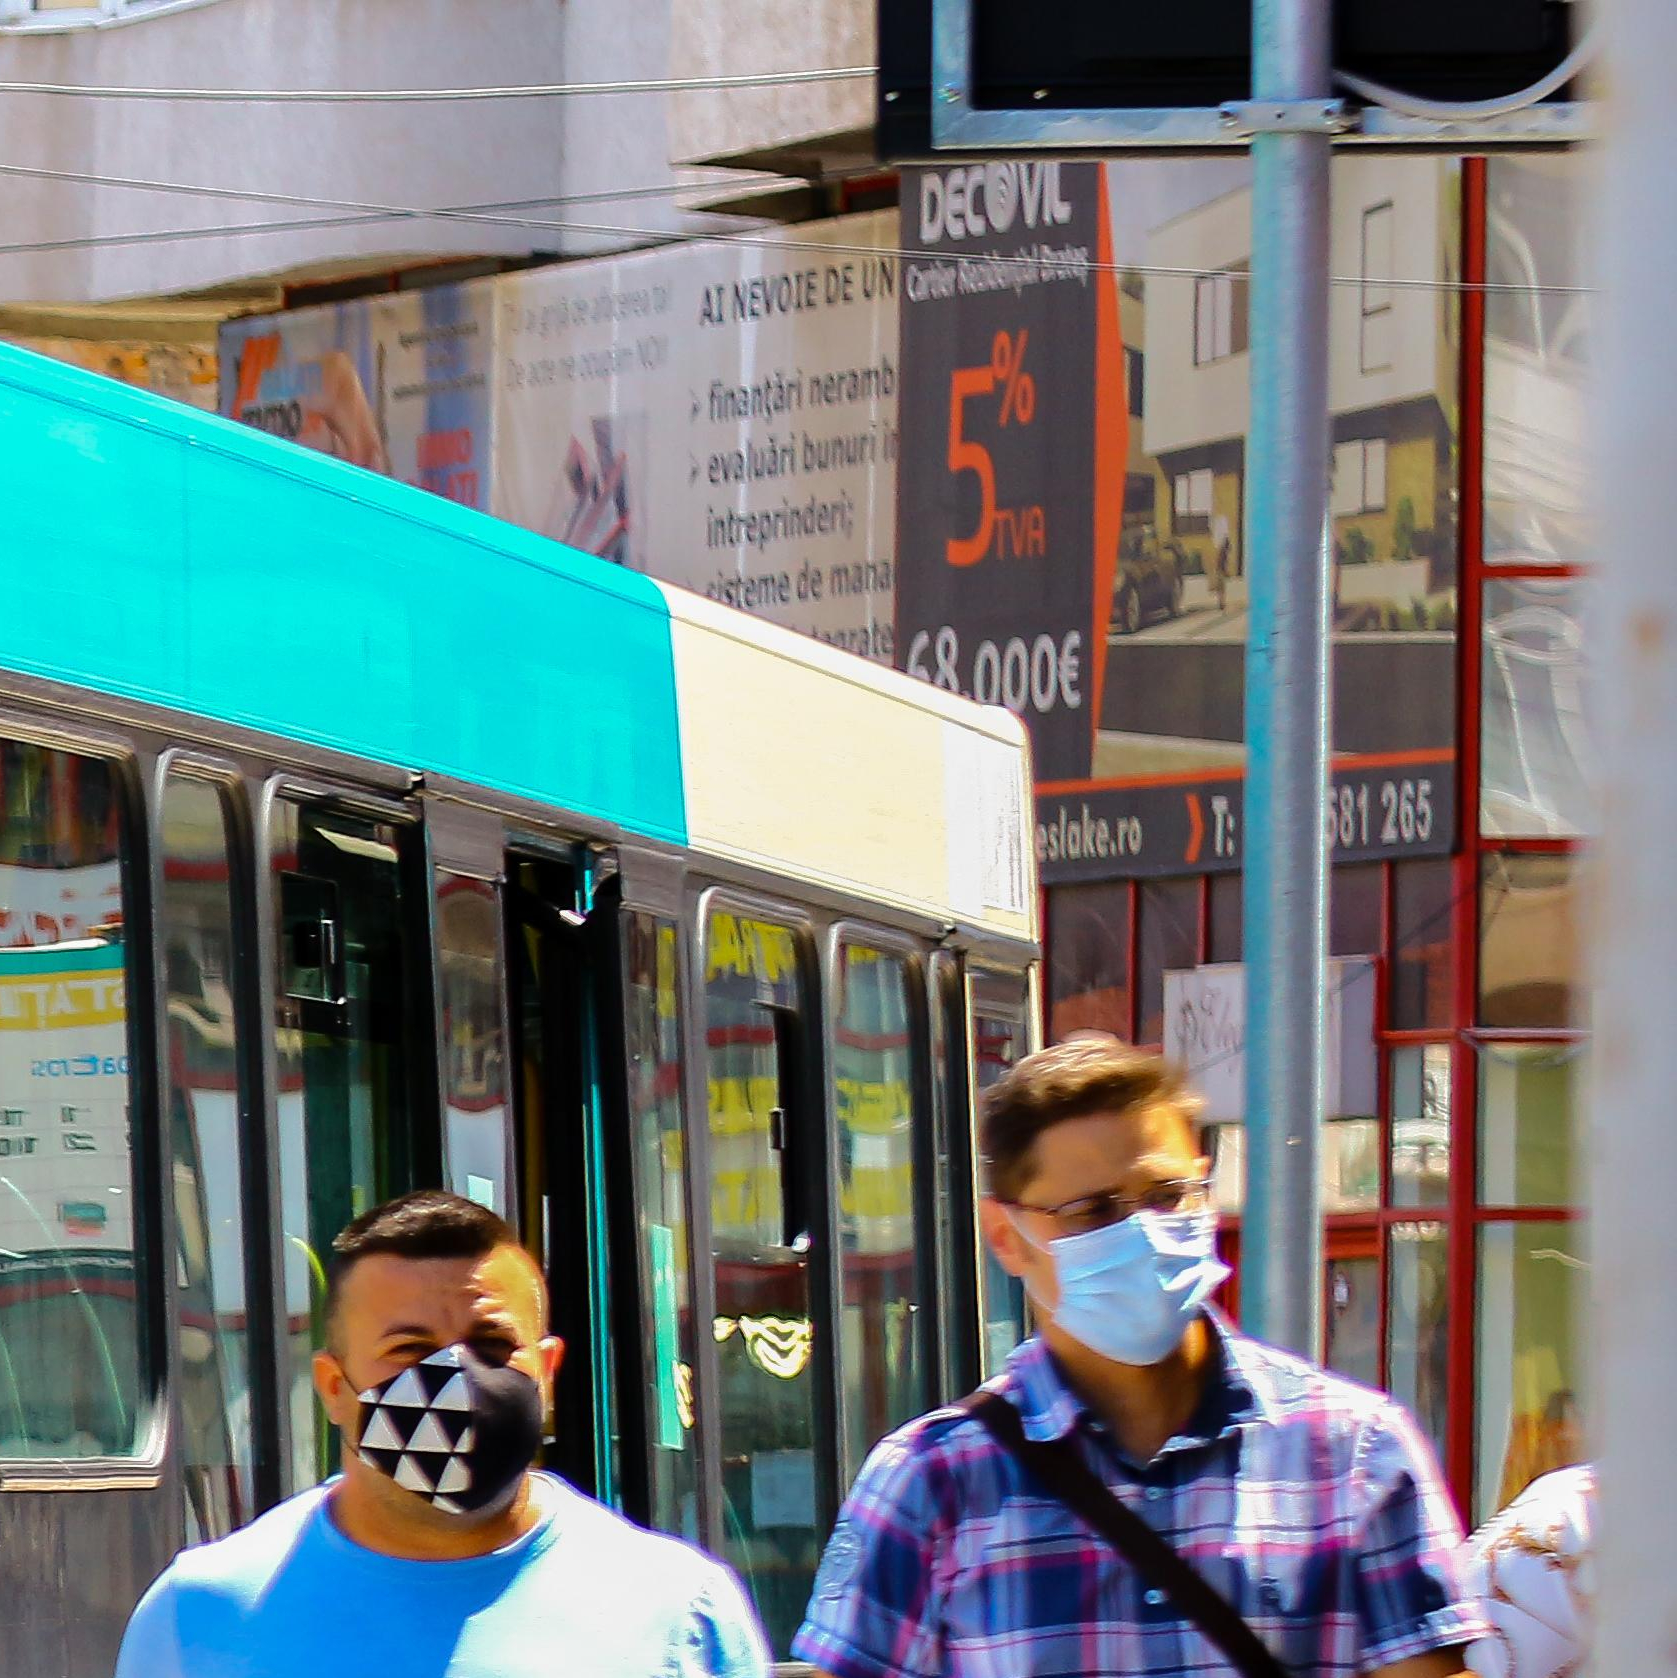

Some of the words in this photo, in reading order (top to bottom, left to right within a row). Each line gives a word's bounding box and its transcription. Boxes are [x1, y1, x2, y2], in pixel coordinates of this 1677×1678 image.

[699, 283, 725, 326] AI
[733, 268, 817, 321] NEVOIE
[824, 263, 855, 305] DE
[707, 366, 803, 426] finanțări
[809, 353, 894, 405] neramb
[708, 431, 796, 485] evaluări
[802, 420, 877, 472] bunuri
[992, 506, 1046, 560] TVA
[796, 557, 823, 602] de
[1380, 778, 1433, 845] 265
